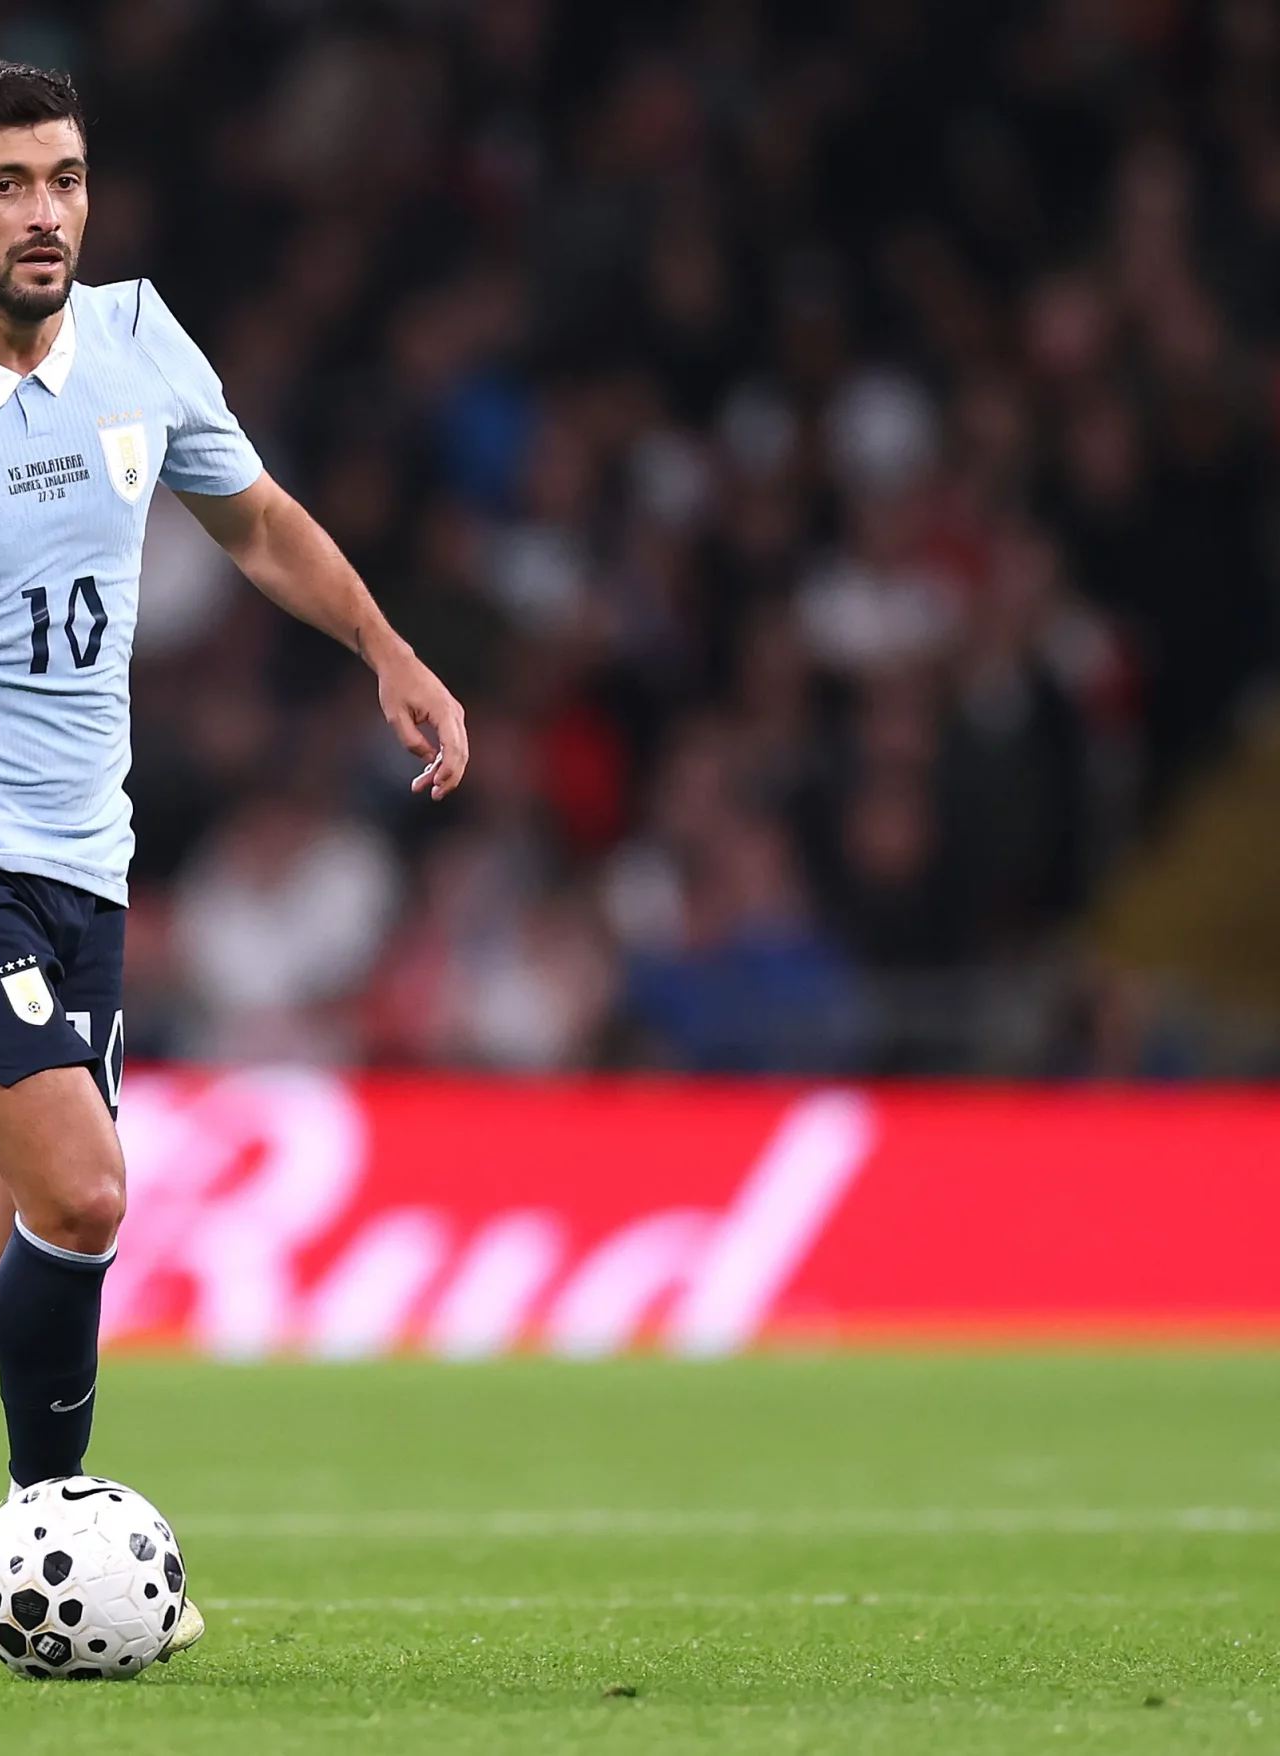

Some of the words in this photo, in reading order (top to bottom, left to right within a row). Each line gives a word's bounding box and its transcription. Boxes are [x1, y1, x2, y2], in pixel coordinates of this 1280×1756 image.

[8, 467, 24, 481] VS.
[25, 454, 85, 478] INGLATERRA
[8, 479, 43, 495] LONDRES,
[44, 469, 90, 488] INGLATERRA
[21, 575, 108, 674] 10
